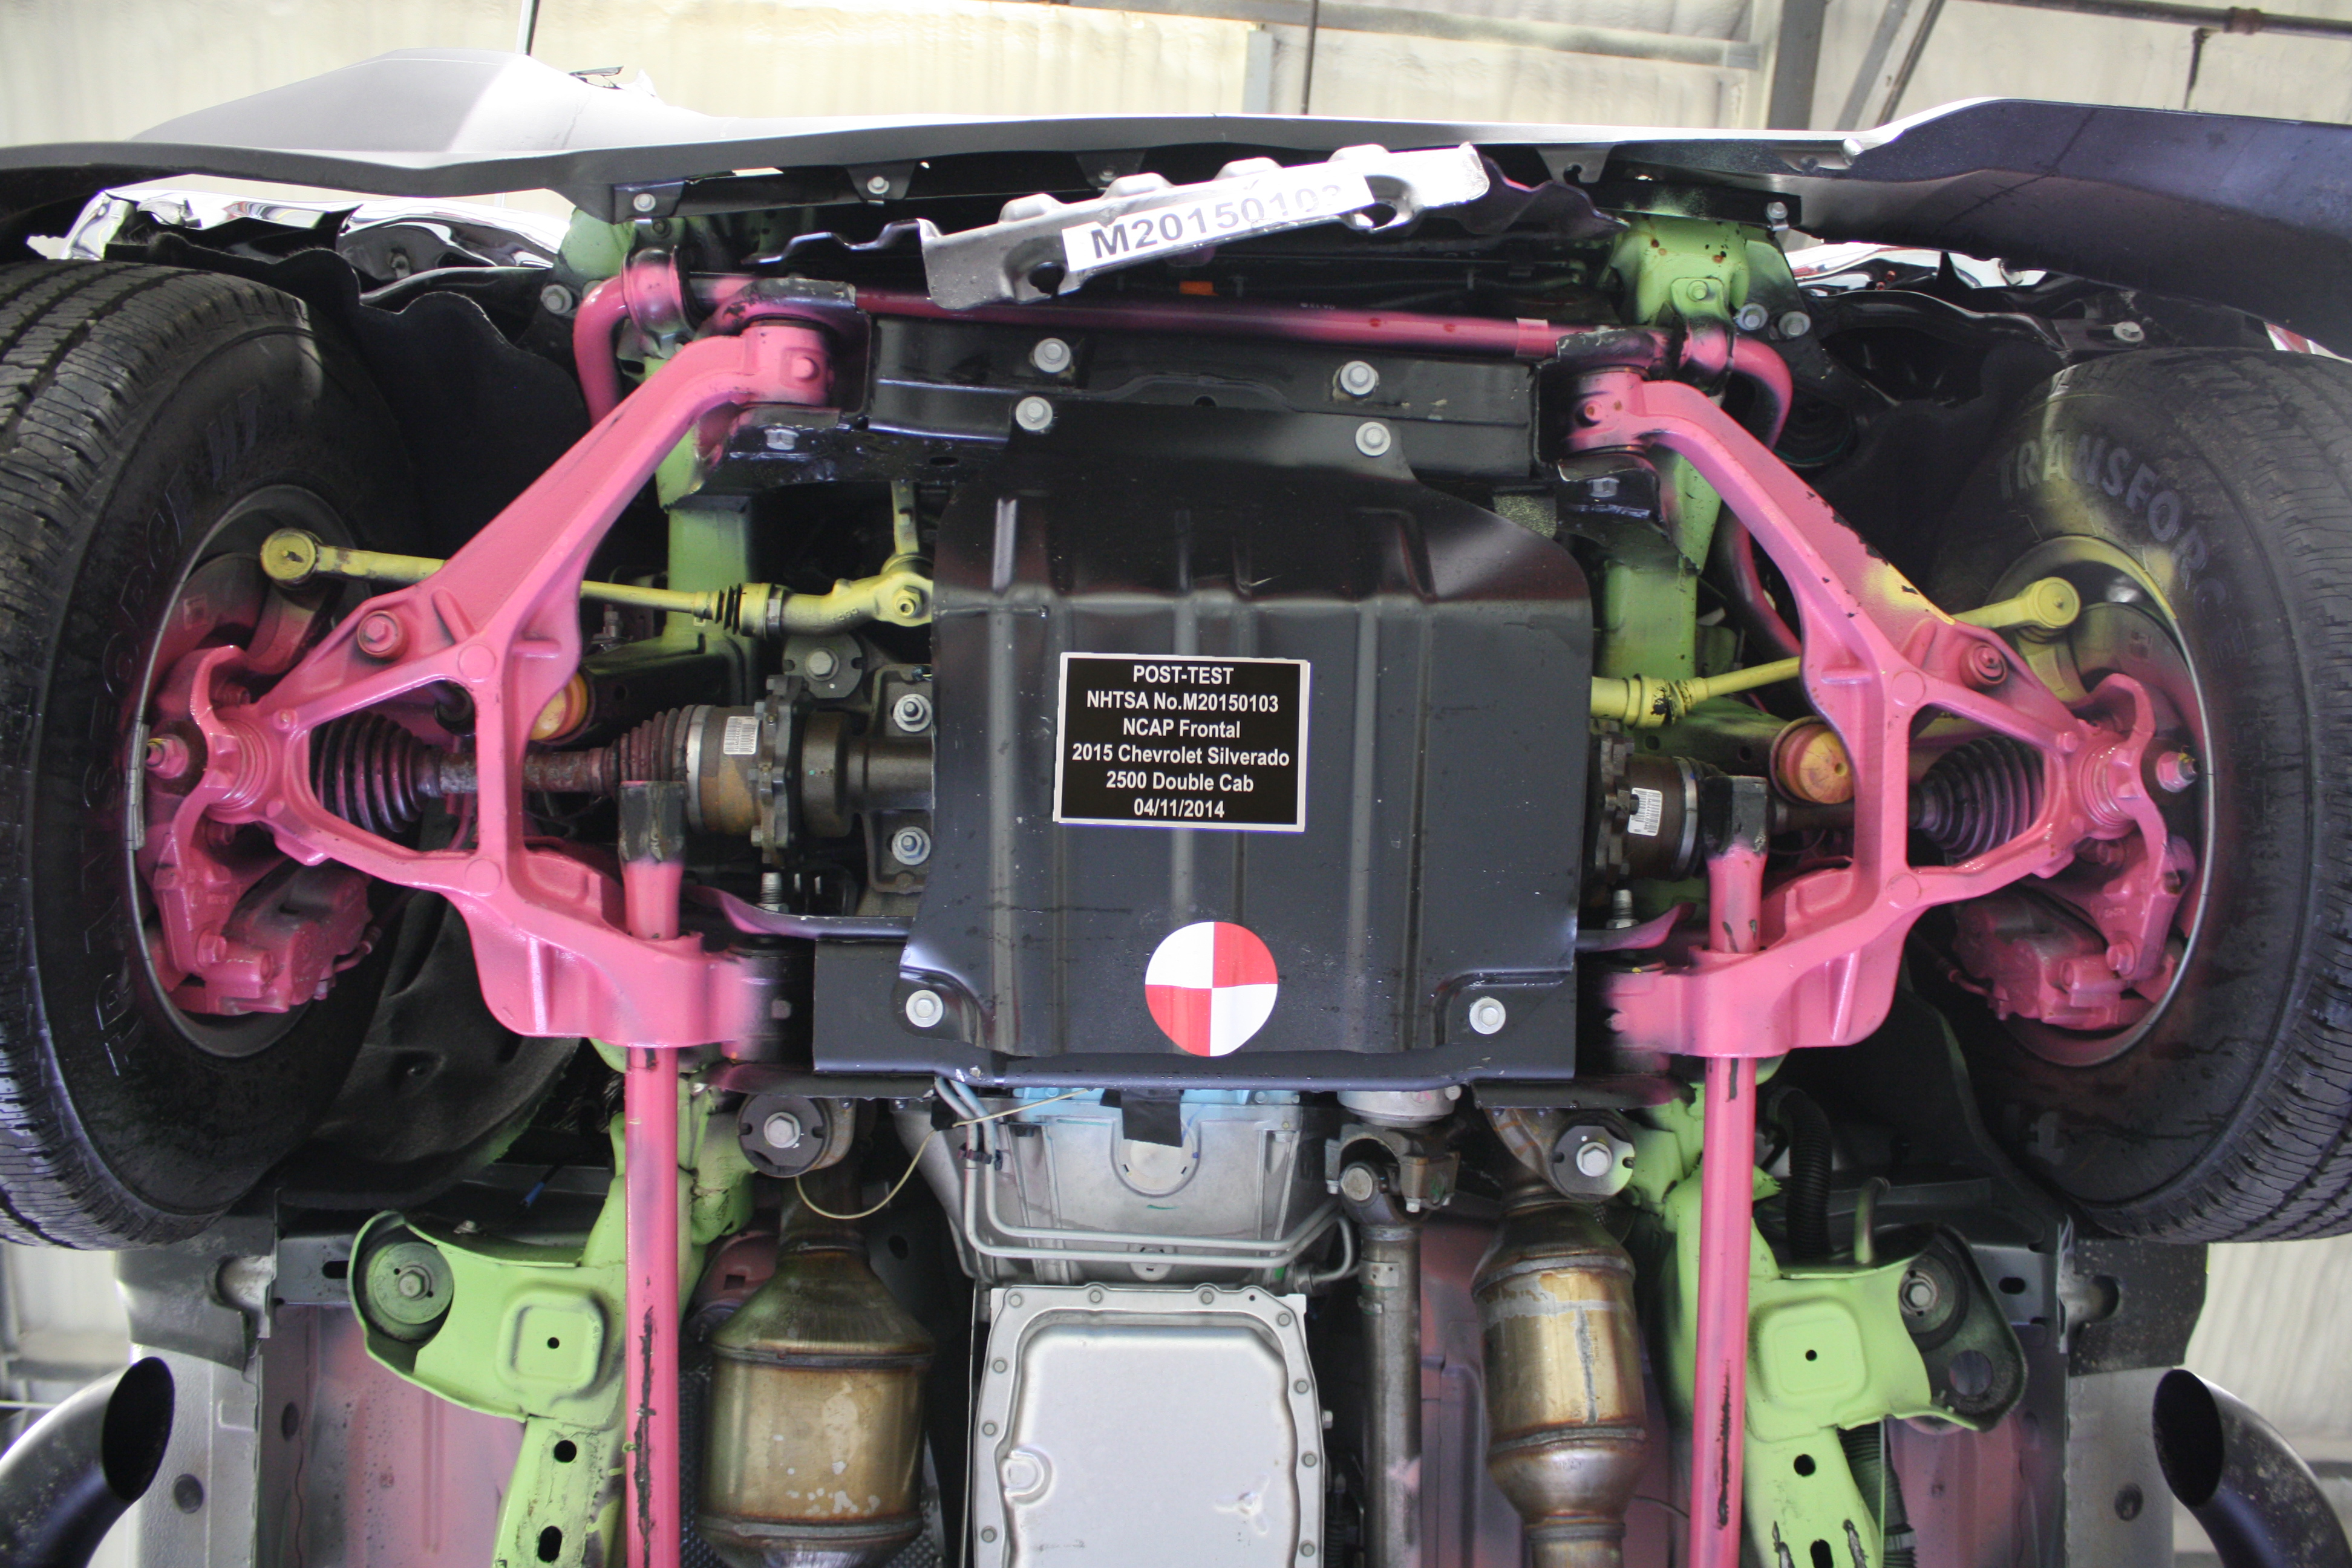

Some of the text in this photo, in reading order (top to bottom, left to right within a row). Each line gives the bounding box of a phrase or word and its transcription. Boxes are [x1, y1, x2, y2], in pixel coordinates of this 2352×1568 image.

[1133, 664, 1234, 685] POST-TEST
[1086, 690, 1279, 713] NHTSA No.M20150103
[1123, 717, 1241, 739] NCAP Frontal
[1072, 743, 1290, 766] 2015 Chevrolet Silverado
[1106, 770, 1254, 792] 2500 Double Cab
[1134, 797, 1225, 818] 04/11/2014
